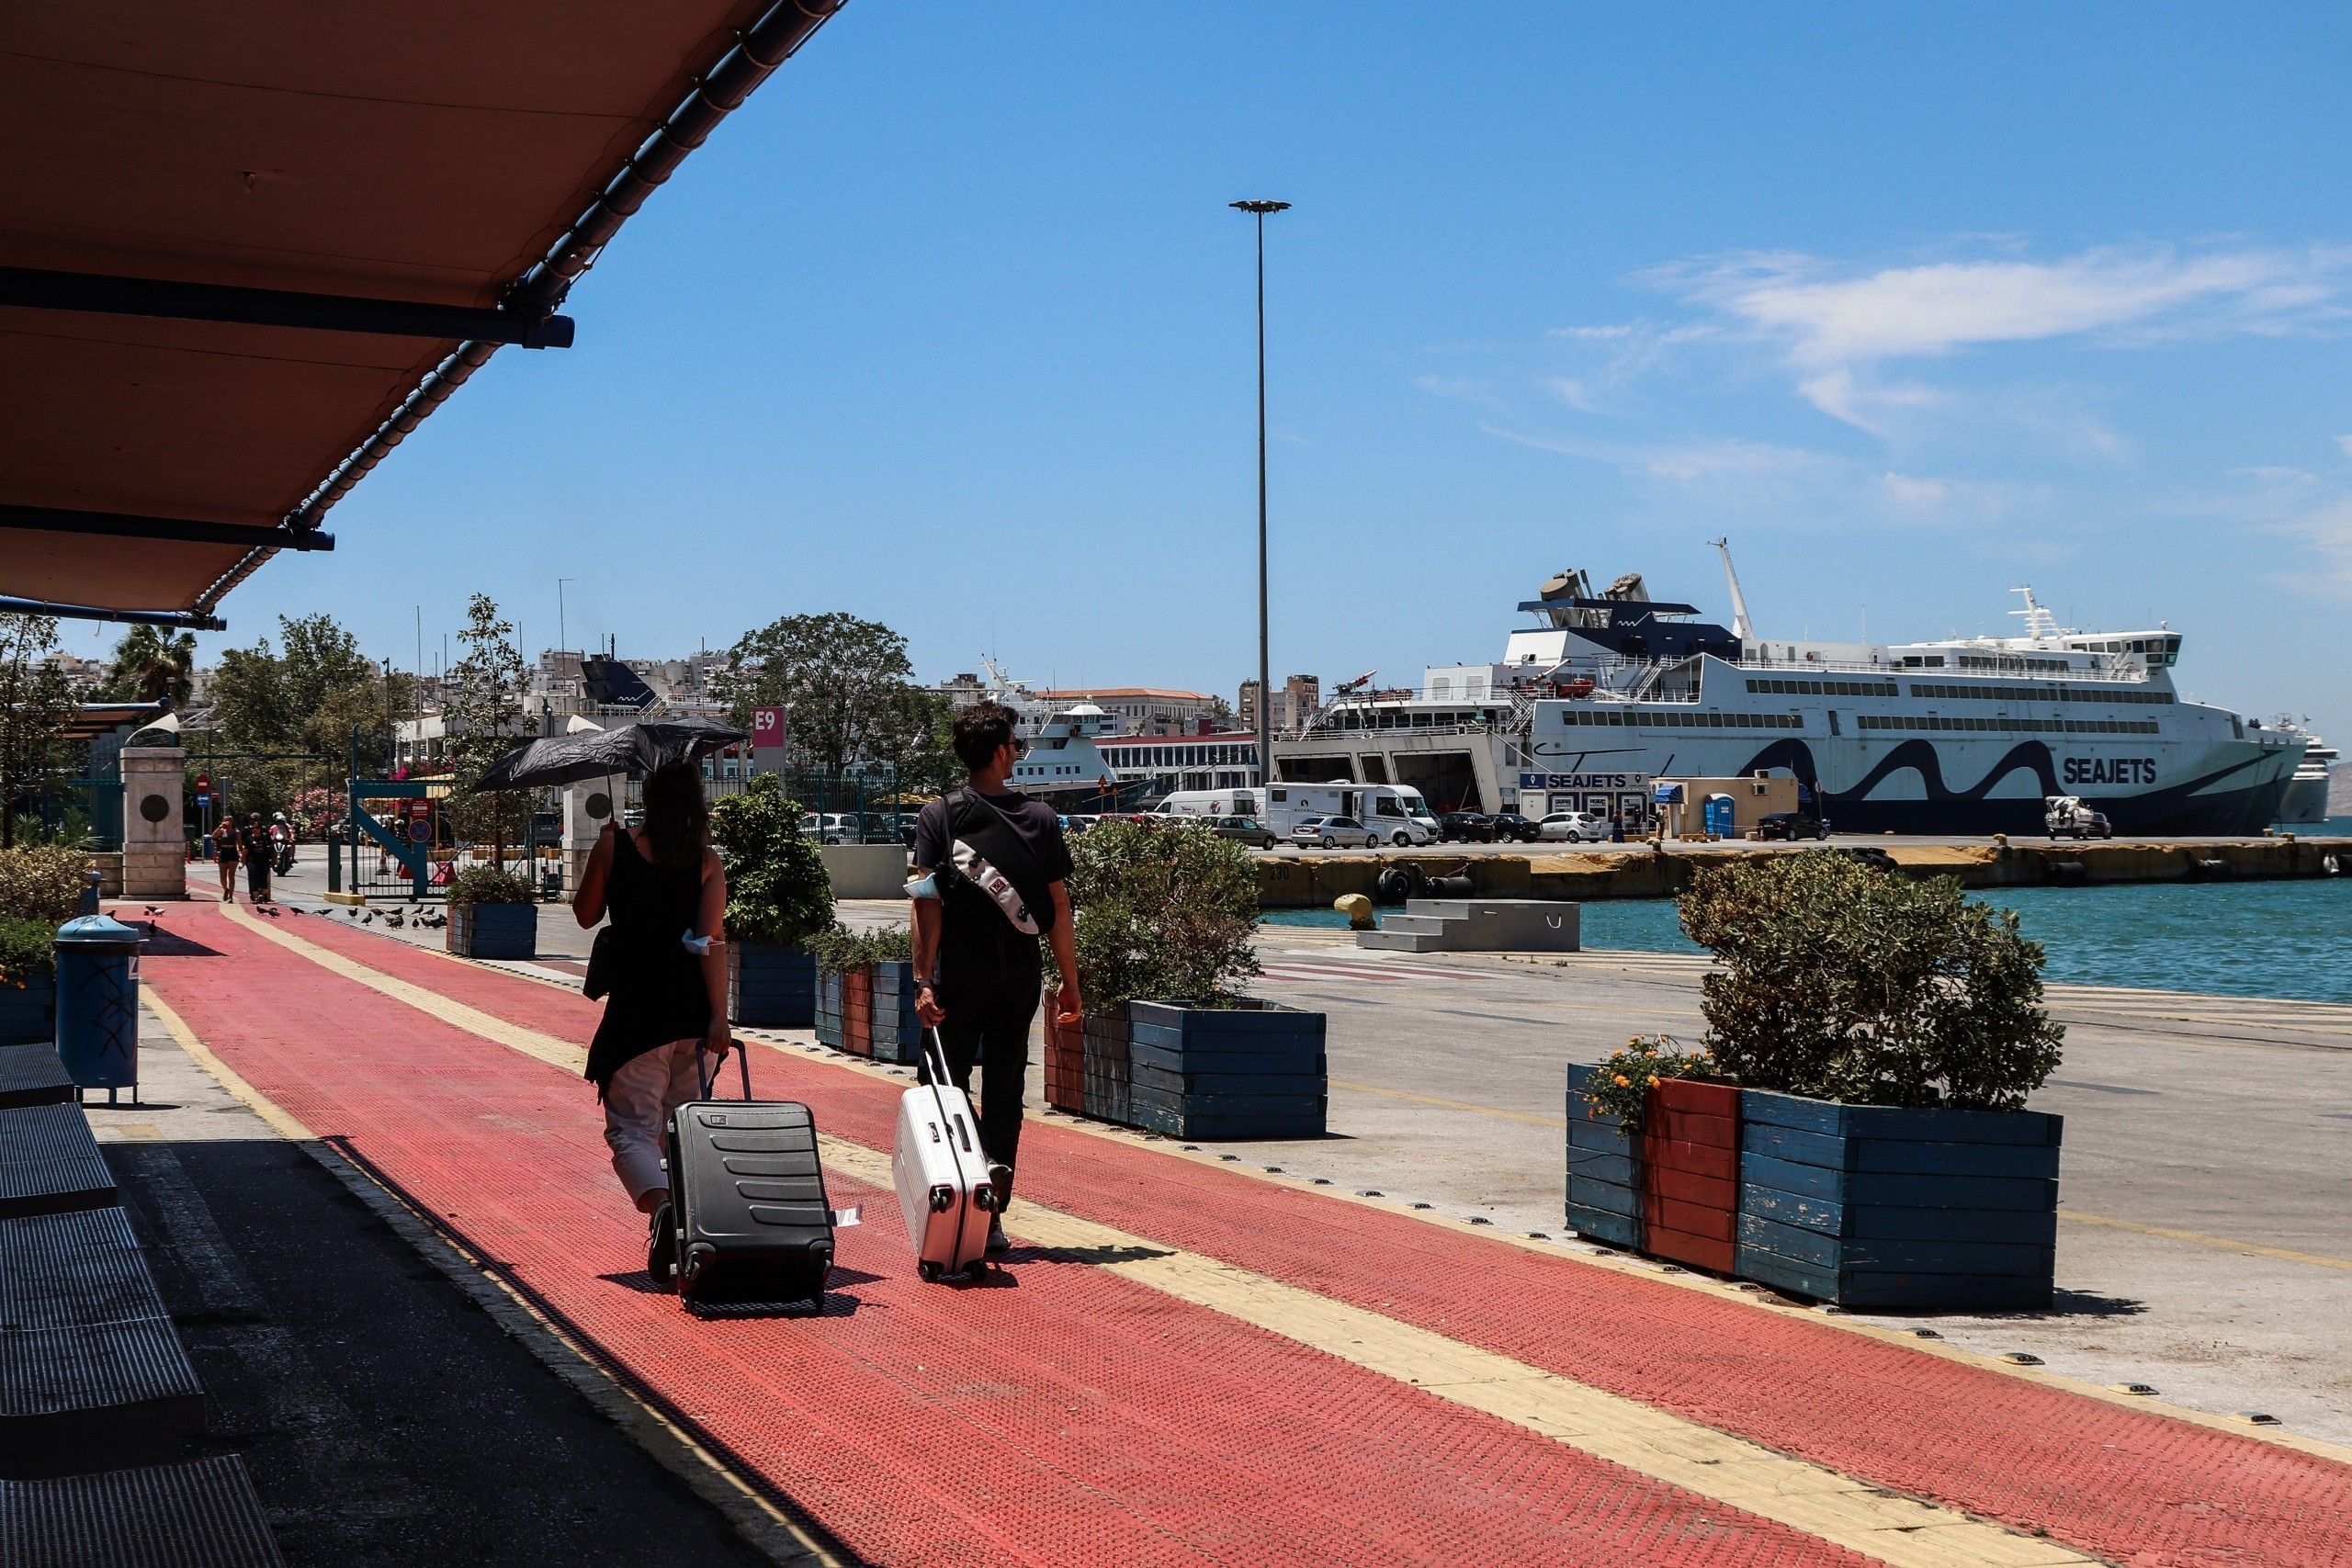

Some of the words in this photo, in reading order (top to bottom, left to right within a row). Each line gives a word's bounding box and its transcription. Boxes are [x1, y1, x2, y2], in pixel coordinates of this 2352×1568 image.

[755, 711, 775, 730] E9
[2063, 757, 2156, 784] SEAJETS
[1548, 774, 1626, 788] SEAJETS
[1270, 865, 1289, 881] 230
